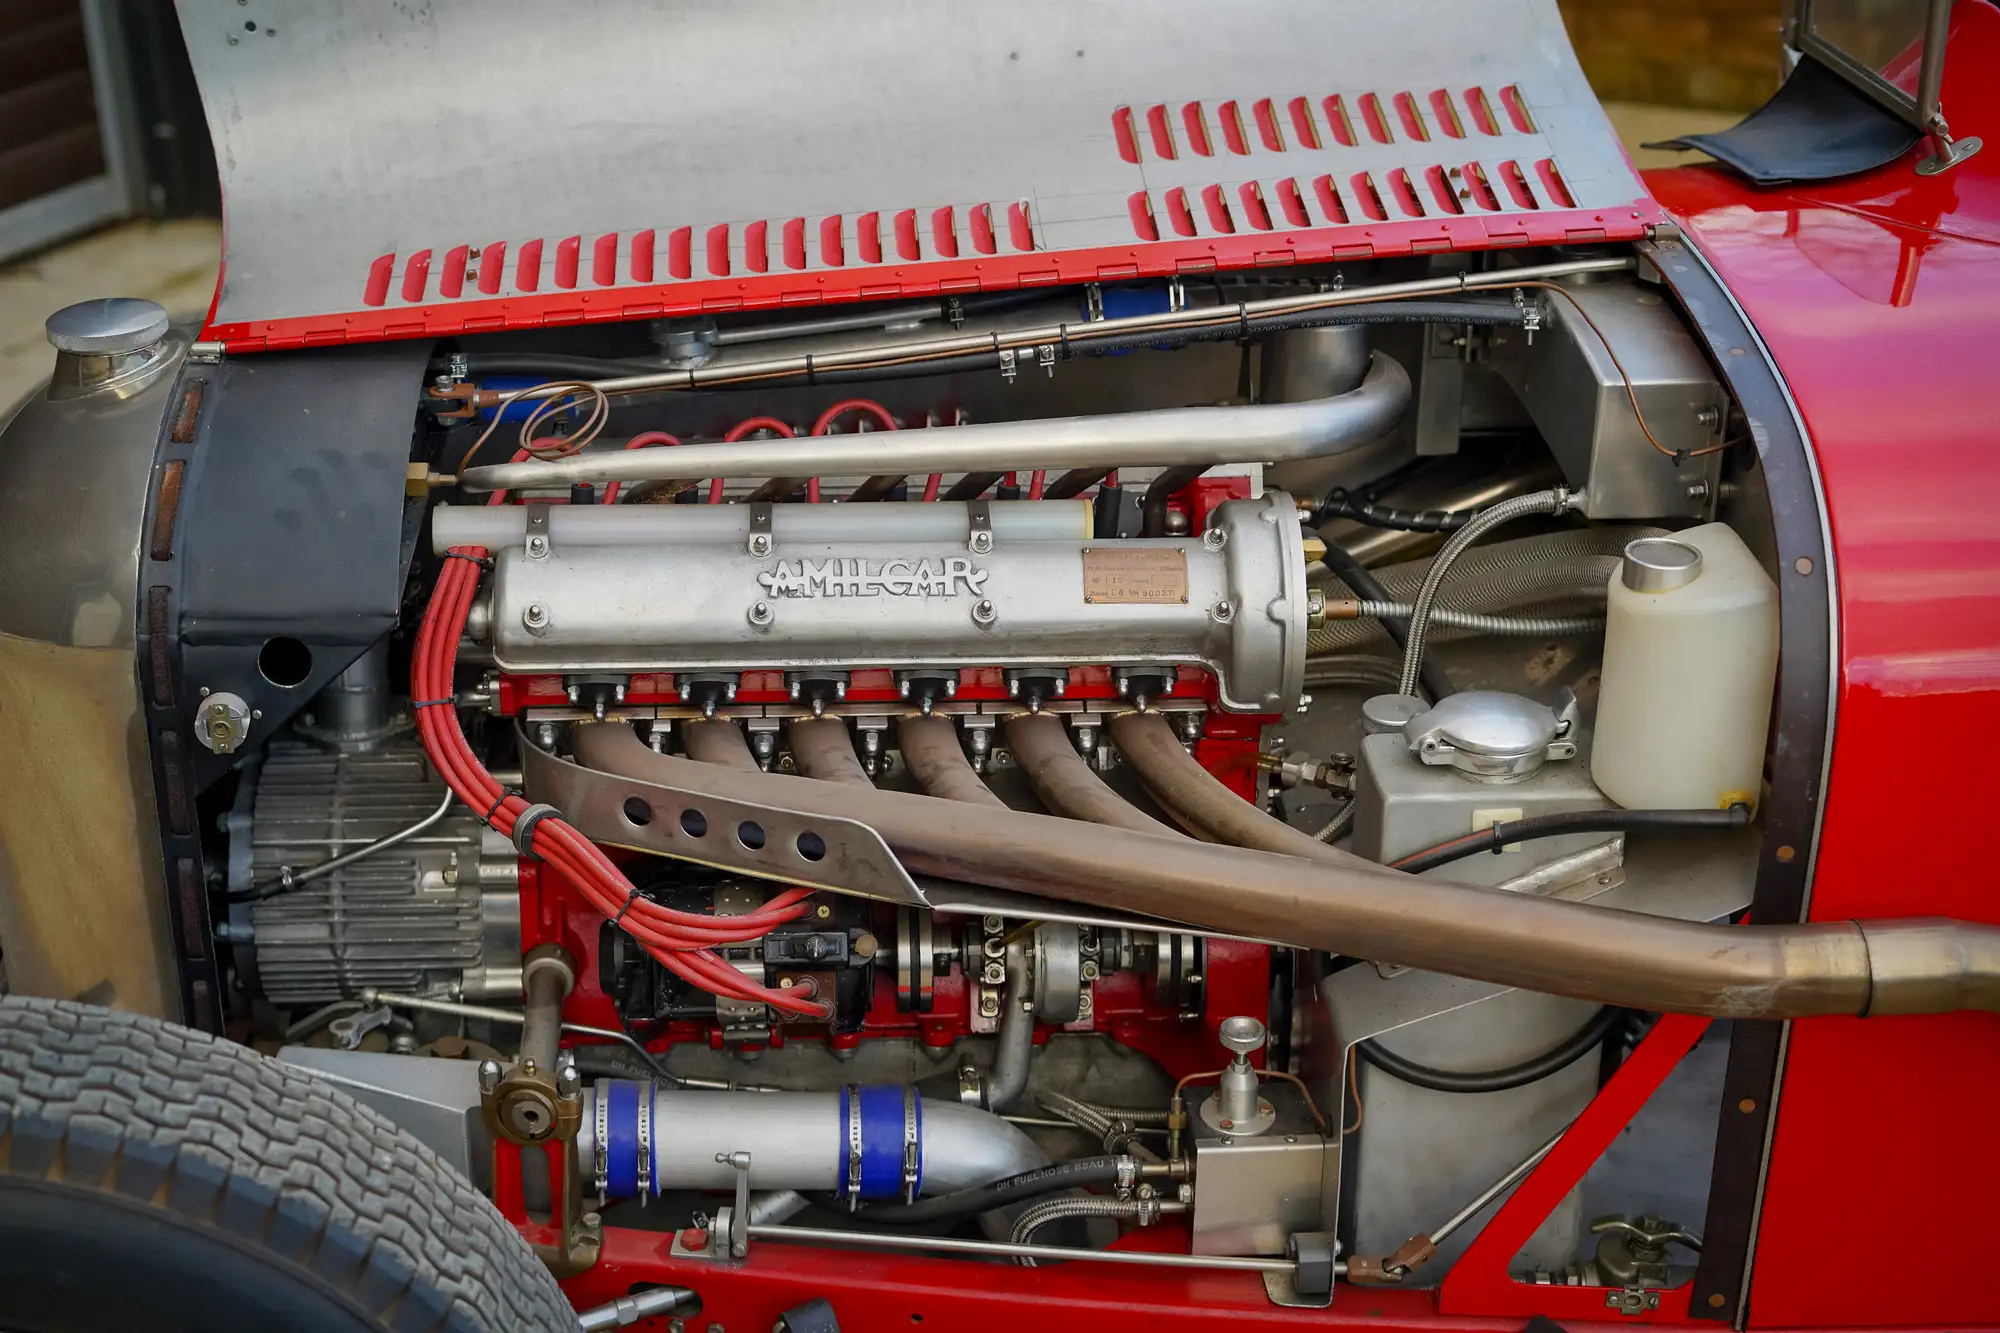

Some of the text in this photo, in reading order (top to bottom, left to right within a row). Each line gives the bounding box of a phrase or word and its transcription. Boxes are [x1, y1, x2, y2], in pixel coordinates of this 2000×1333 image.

[757, 558, 989, 597] AMILCAR
[1112, 576, 1123, 584] 12
[629, 1065, 652, 1080] FUEL
[1014, 1172, 1040, 1187] FUEL
[1041, 1166, 1070, 1179] HOSE
[1074, 1159, 1104, 1172] BSAU
